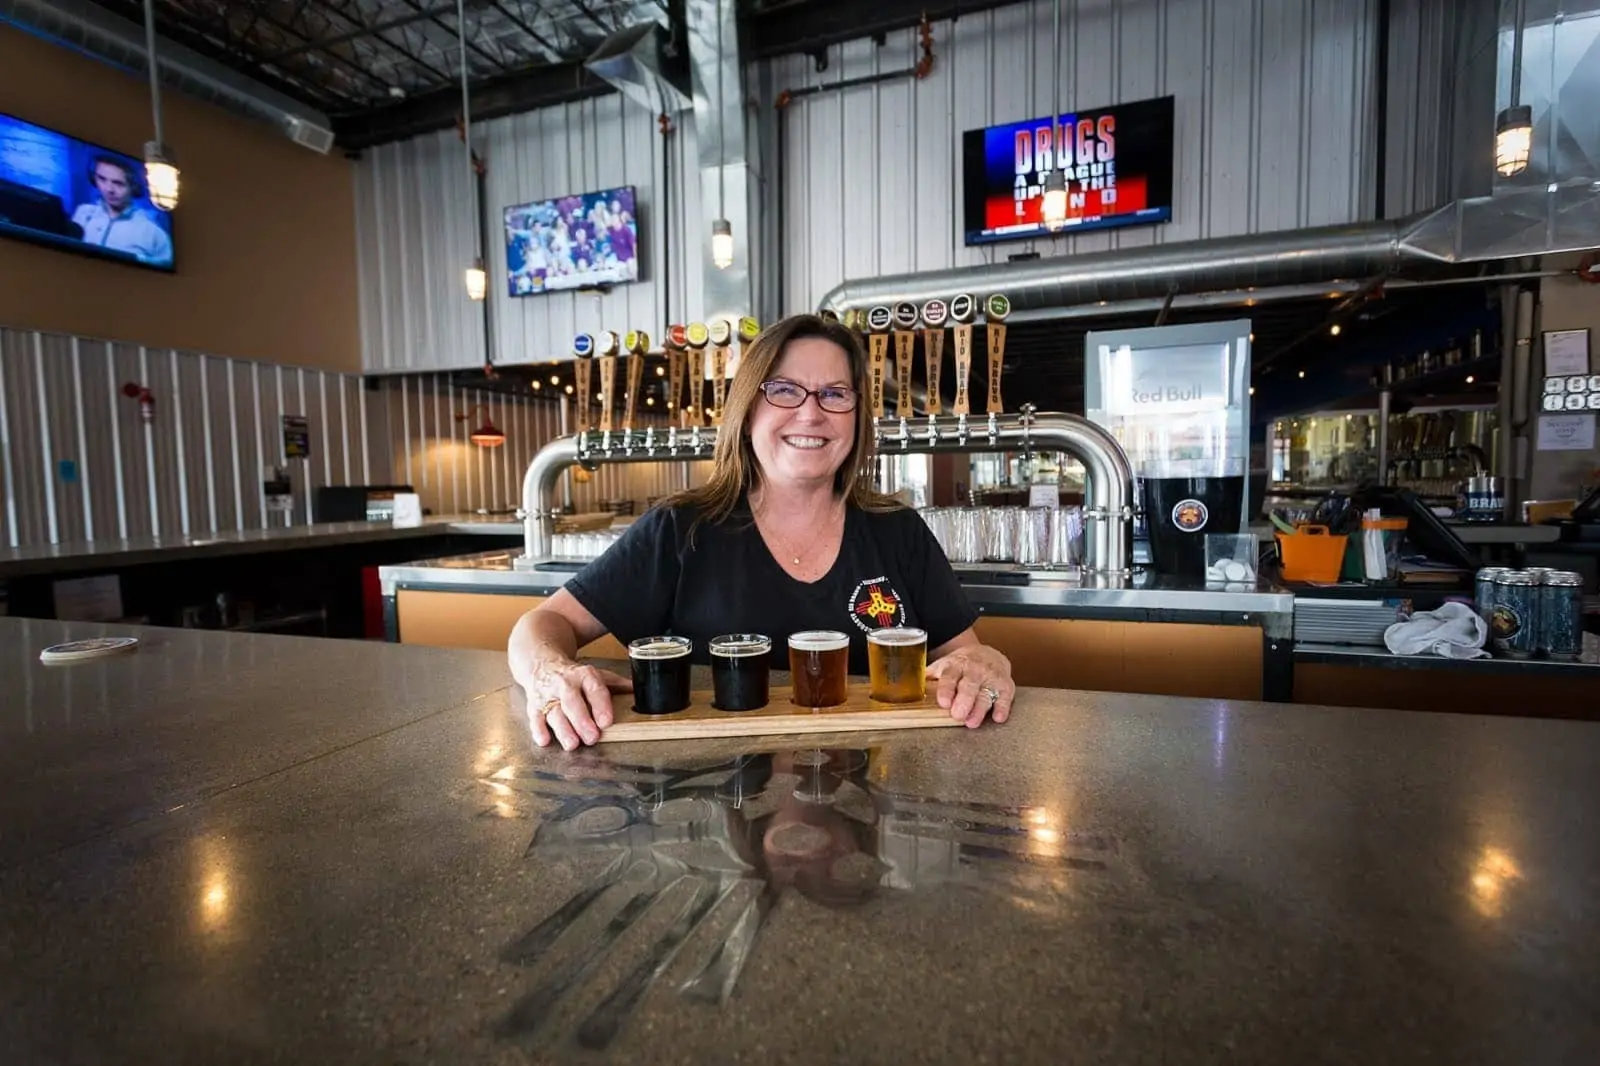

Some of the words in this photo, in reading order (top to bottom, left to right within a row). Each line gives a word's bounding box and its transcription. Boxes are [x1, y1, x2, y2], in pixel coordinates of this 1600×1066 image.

[1014, 115, 1116, 175] DRUGS
[1014, 174, 1027, 188] A
[1038, 161, 1116, 185] PAGUE
[1079, 175, 1116, 193] THE
[1015, 188, 1117, 216] LND
[1167, 383, 1202, 402] Bull
